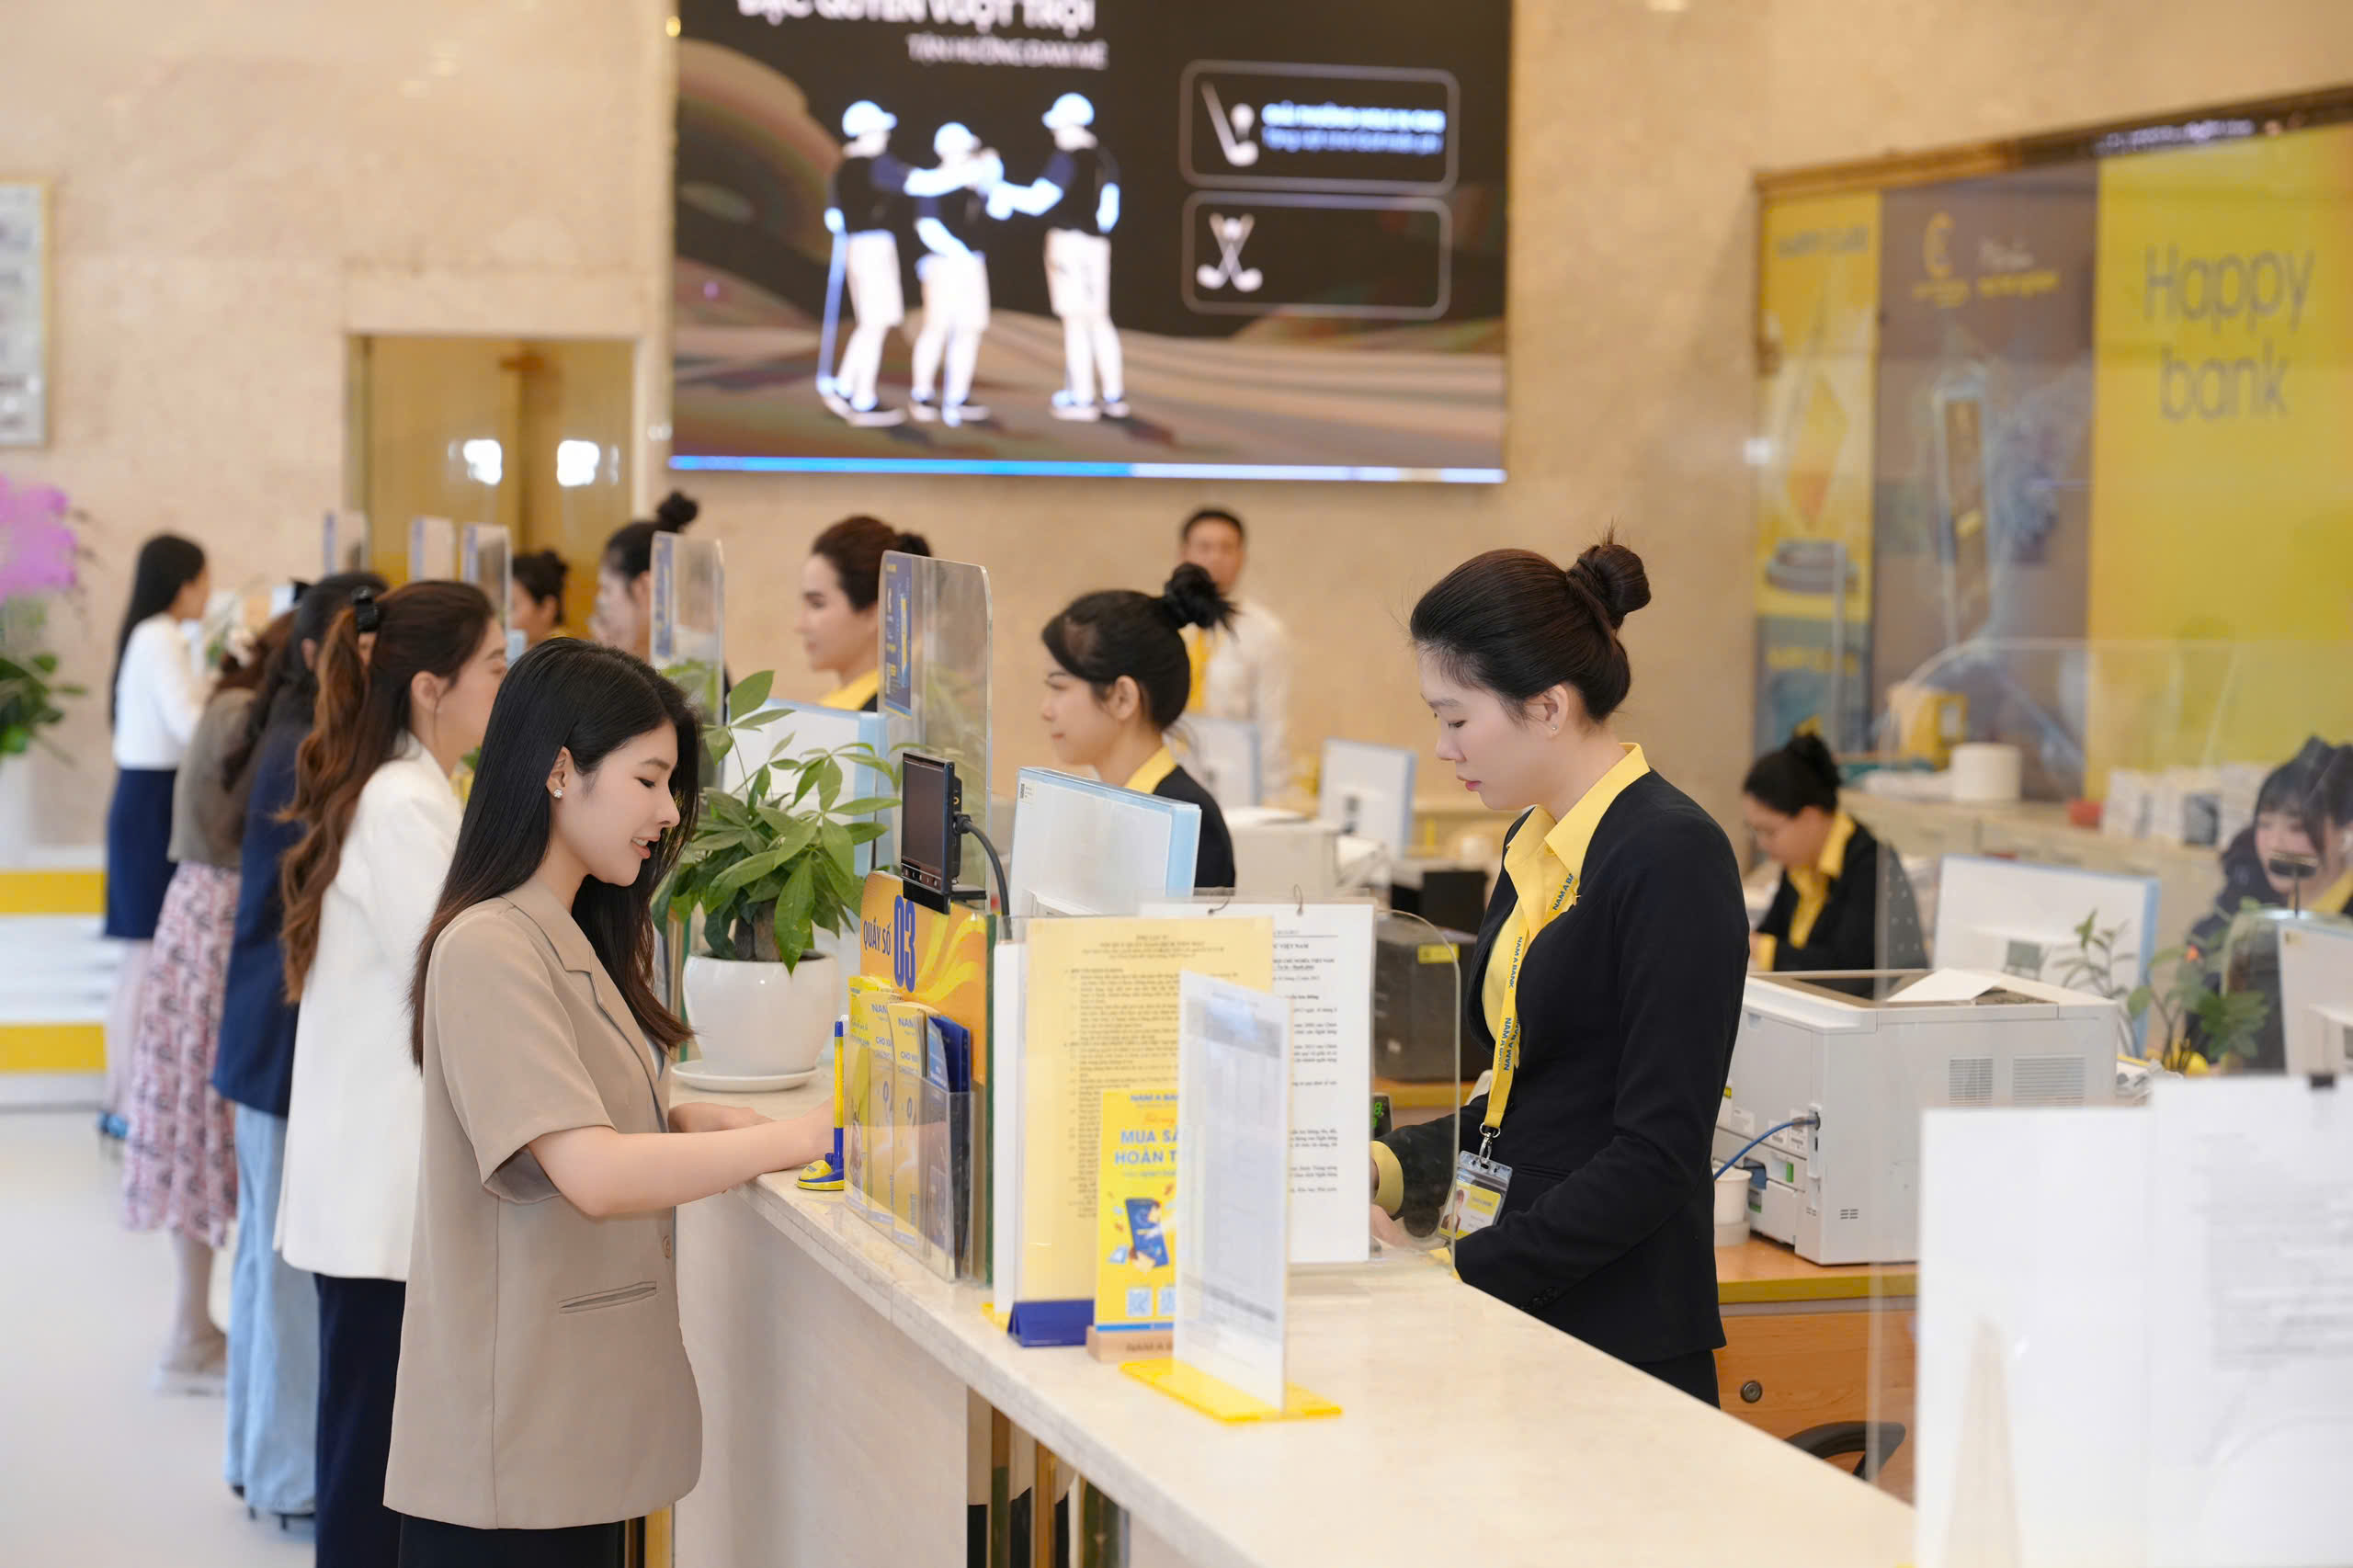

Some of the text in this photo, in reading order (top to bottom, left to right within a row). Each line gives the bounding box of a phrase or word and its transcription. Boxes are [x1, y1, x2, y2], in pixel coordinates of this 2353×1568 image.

[2143, 241, 2316, 335] Happy
[2160, 336, 2289, 423] bank
[1552, 891, 1565, 911] NAM
[894, 894, 915, 994] 03
[1514, 936, 1523, 957] NAM
[1508, 964, 1518, 989] BANK
[1502, 1017, 1511, 1039] NAM
[1120, 1130, 1155, 1143] MUA
